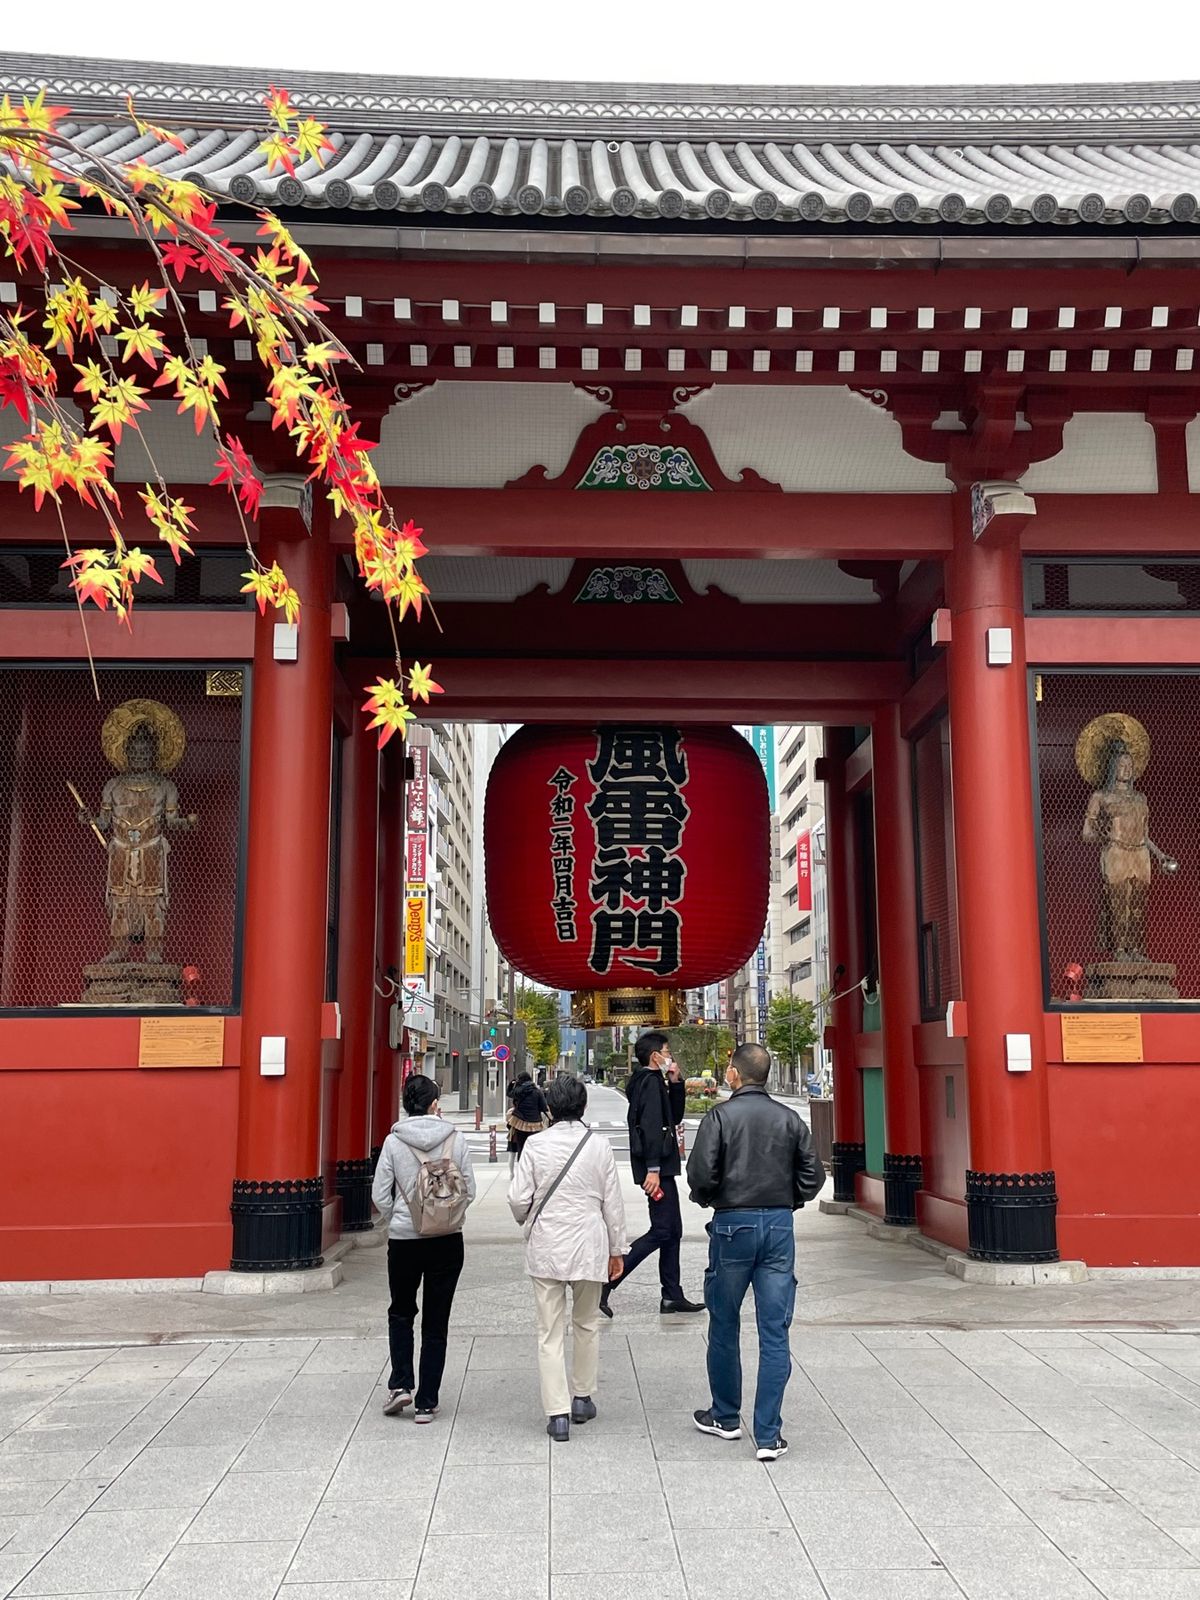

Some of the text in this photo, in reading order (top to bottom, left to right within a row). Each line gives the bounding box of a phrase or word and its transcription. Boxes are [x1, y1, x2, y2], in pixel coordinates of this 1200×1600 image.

[547, 765, 579, 943] 令和二年四月吉日
[584, 724, 691, 977] 風雷神門
[799, 843, 809, 878] 北陸銀行
[407, 900, 424, 942] Denny's
